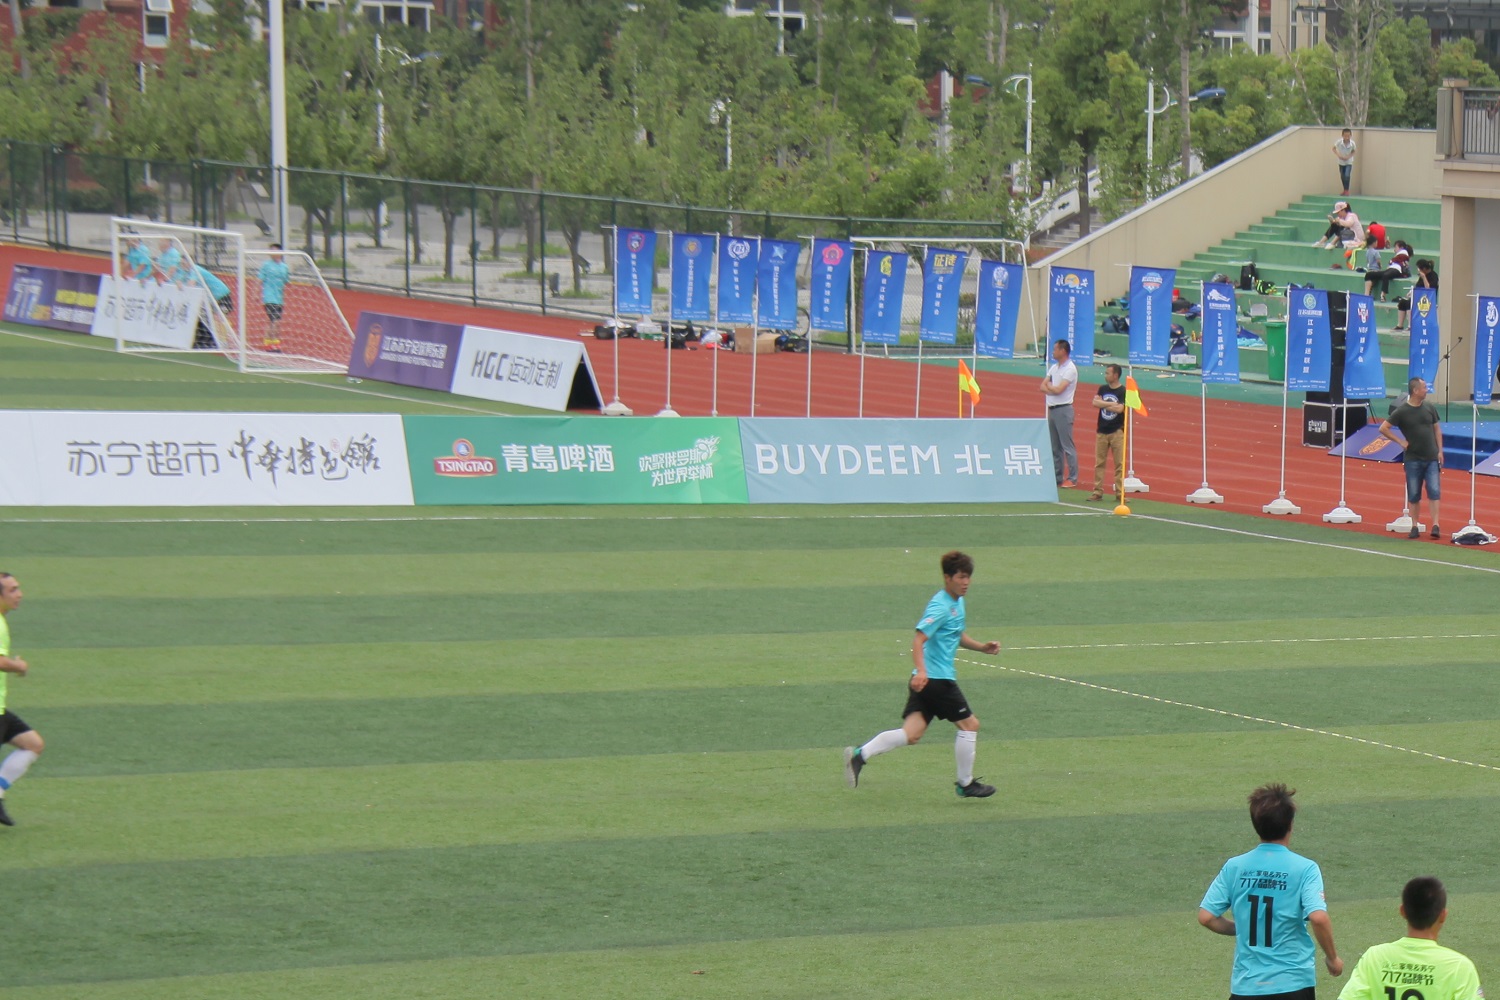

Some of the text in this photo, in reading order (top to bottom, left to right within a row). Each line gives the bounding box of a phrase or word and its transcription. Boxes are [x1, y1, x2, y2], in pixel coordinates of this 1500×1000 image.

[381, 335, 449, 360] 江苏苏宁足球俱乐部
[66, 440, 221, 477] 苏宁超市
[437, 460, 494, 473] TSINGTAO
[502, 444, 615, 473] 青岛啤酒
[638, 448, 702, 473] 欢聚俄罗斯
[754, 443, 1043, 476] BUYDEEM 北鼎
[651, 463, 714, 487] 为世界举杯
[1247, 894, 1274, 947] 11
